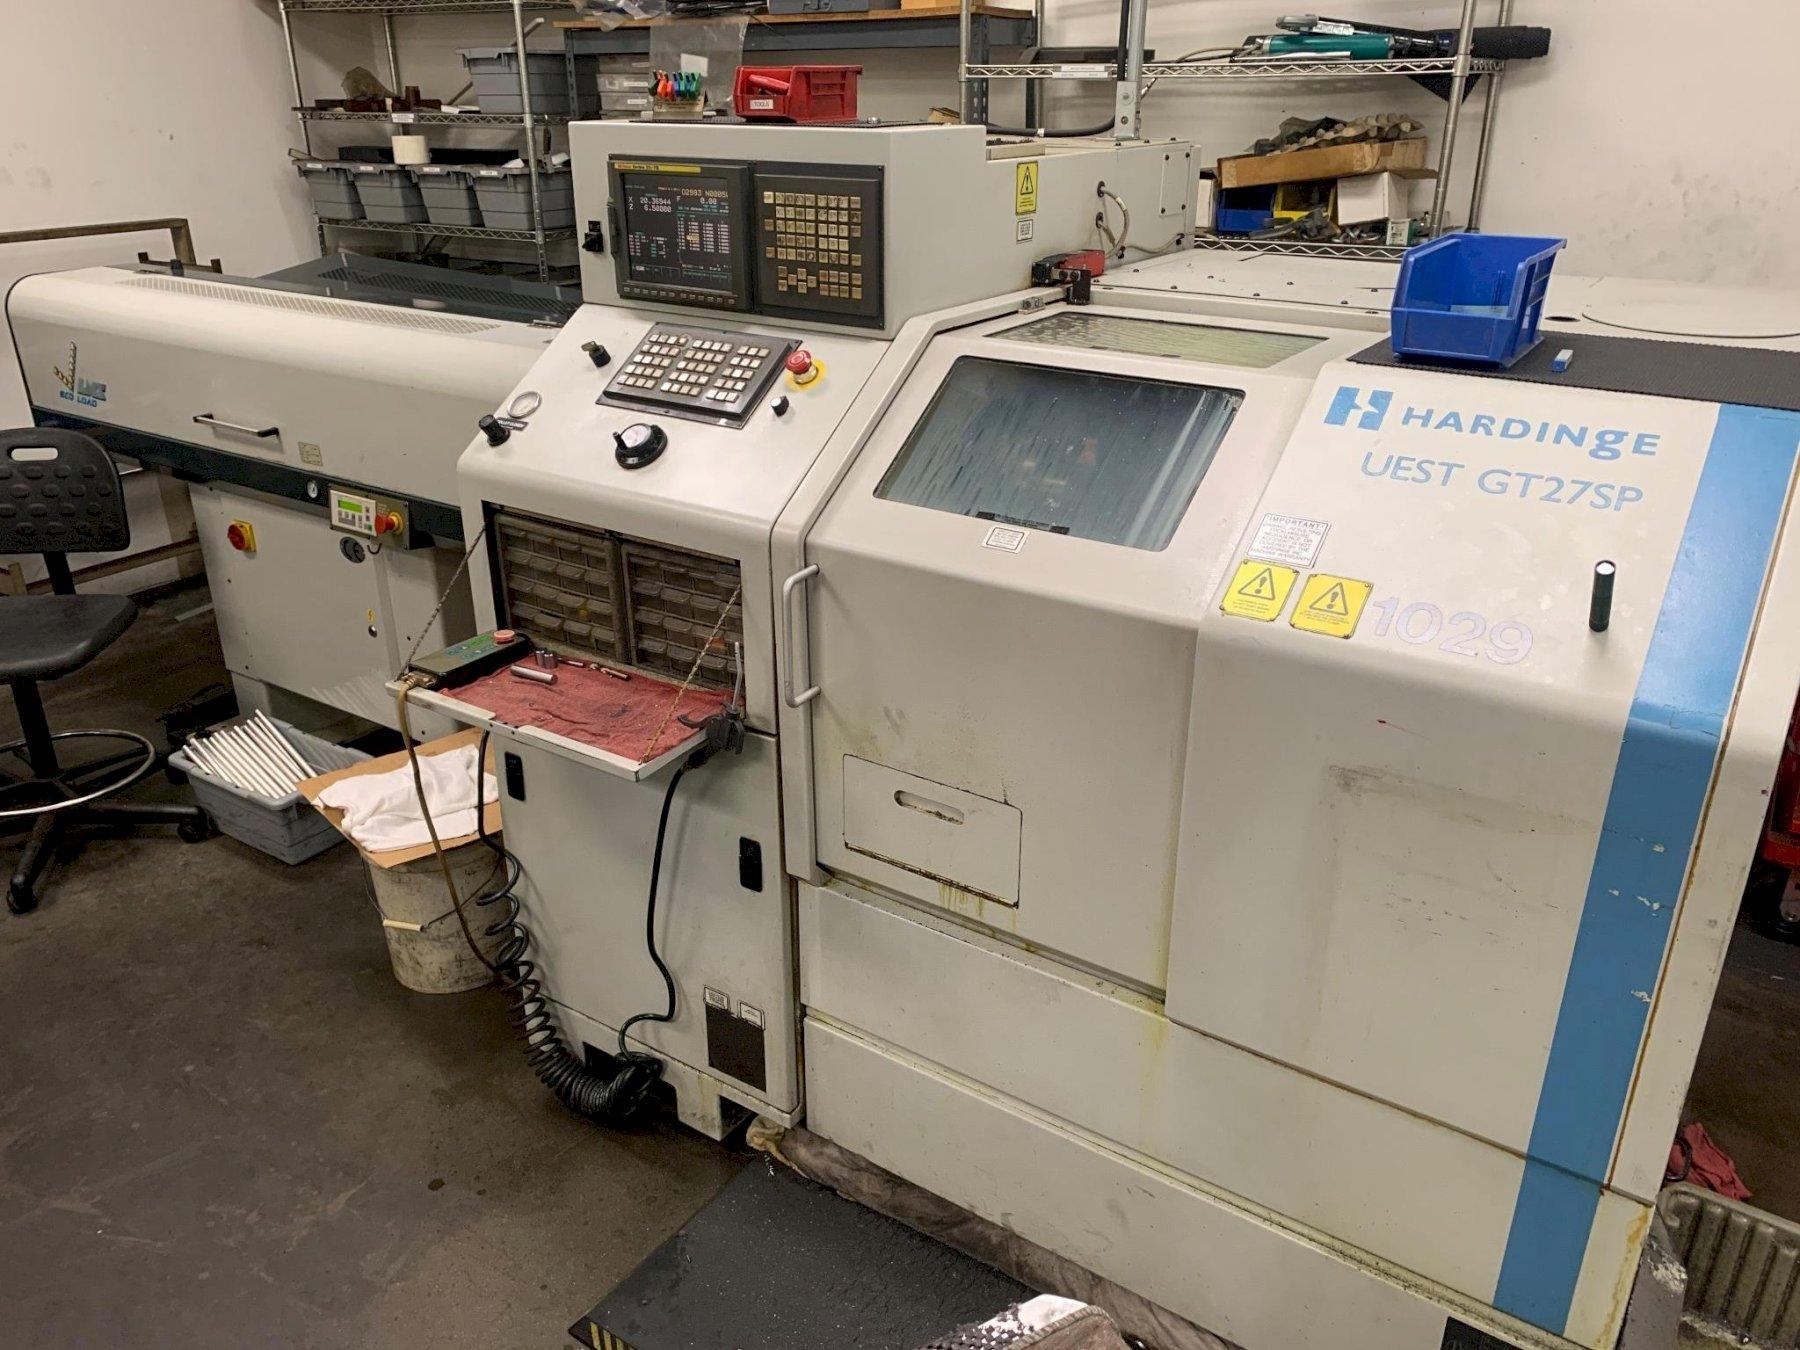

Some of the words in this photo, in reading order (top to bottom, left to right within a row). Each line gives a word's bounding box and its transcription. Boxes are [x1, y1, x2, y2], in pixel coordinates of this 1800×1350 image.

[60, 390, 74, 402] ECO
[77, 396, 98, 408] LOAD
[1361, 451, 1465, 487] UEST
[1477, 468, 1644, 513] GT27SP
[1373, 596, 1534, 666] 1029
